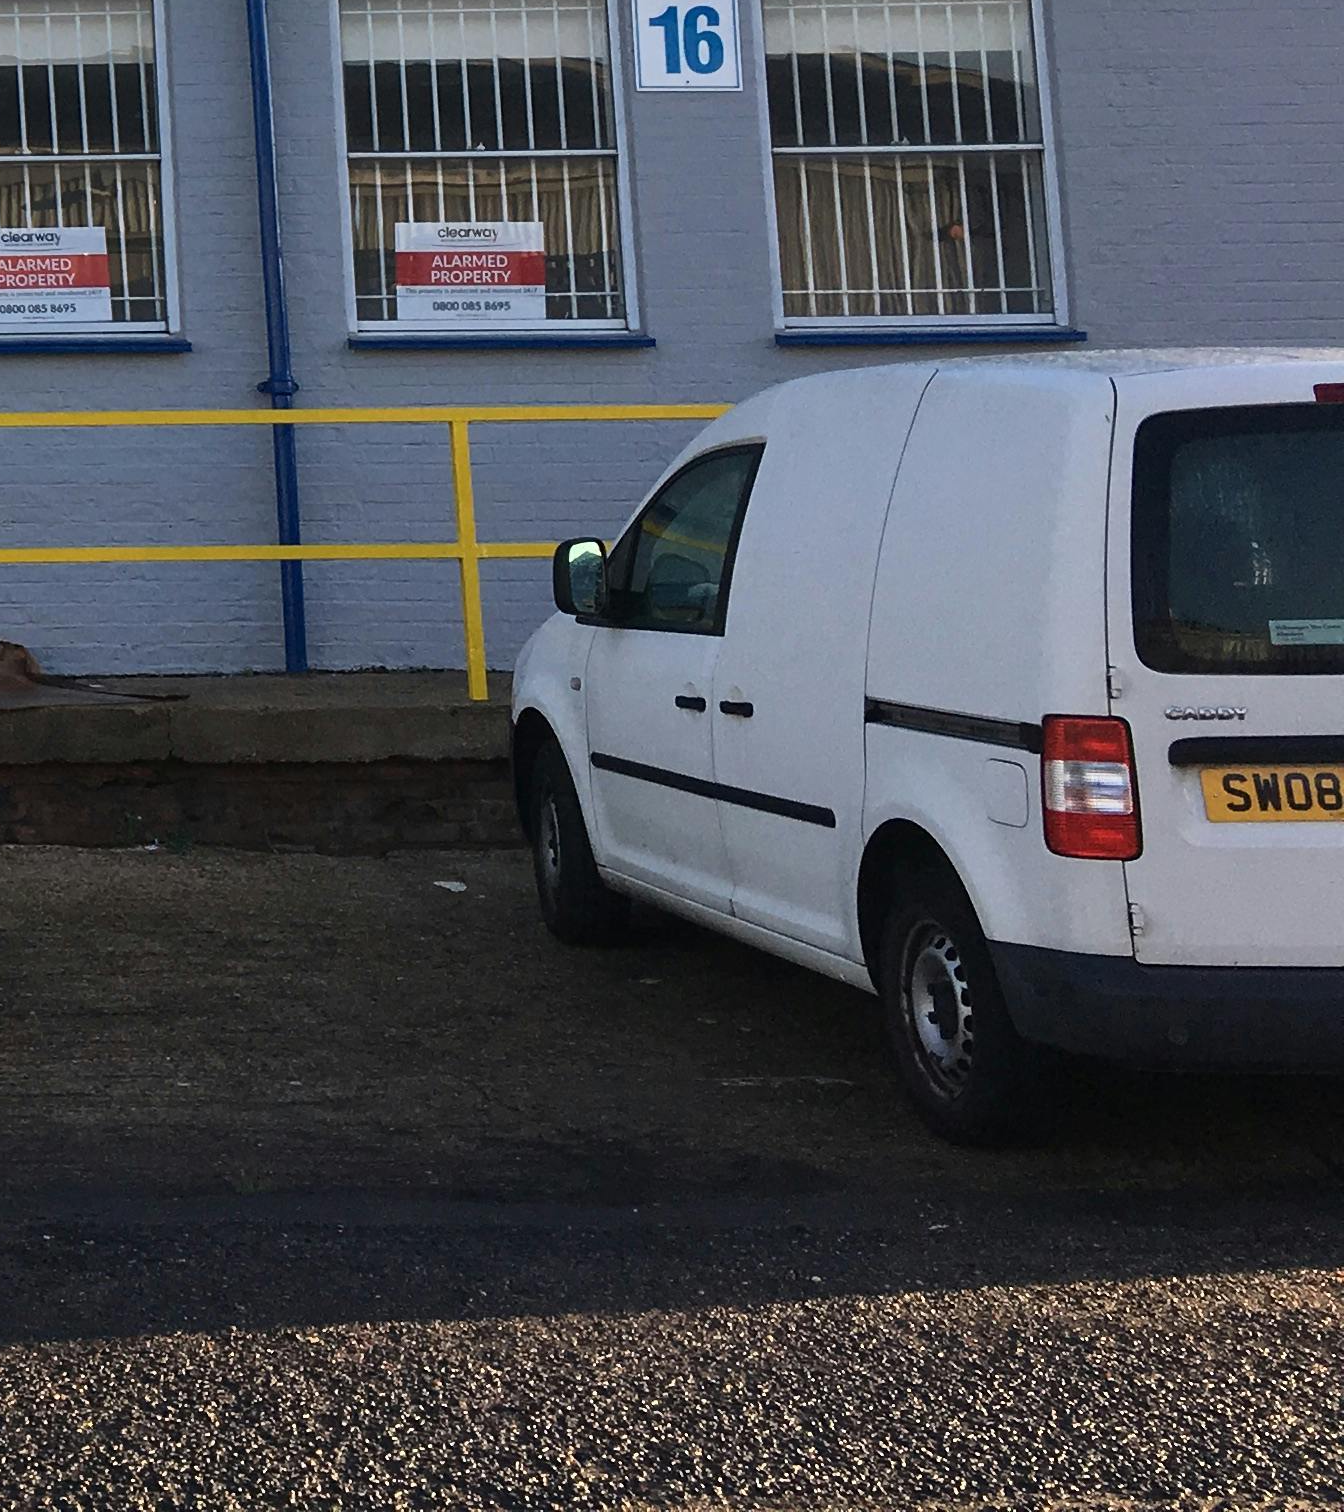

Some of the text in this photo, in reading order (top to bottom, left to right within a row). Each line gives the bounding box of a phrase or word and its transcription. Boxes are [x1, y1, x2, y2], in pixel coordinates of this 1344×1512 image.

[649, 5, 724, 75] 16
[0, 231, 62, 246] clearway
[437, 226, 499, 243] clearway
[432, 254, 508, 268] ALARMED
[430, 270, 512, 284] PROPERTY
[27, 303, 48, 314] 085
[49, 302, 77, 313] 8695
[432, 300, 512, 311] 0800 085 8695
[1164, 705, 1247, 721] CADDY
[1222, 772, 1344, 813] SW08
